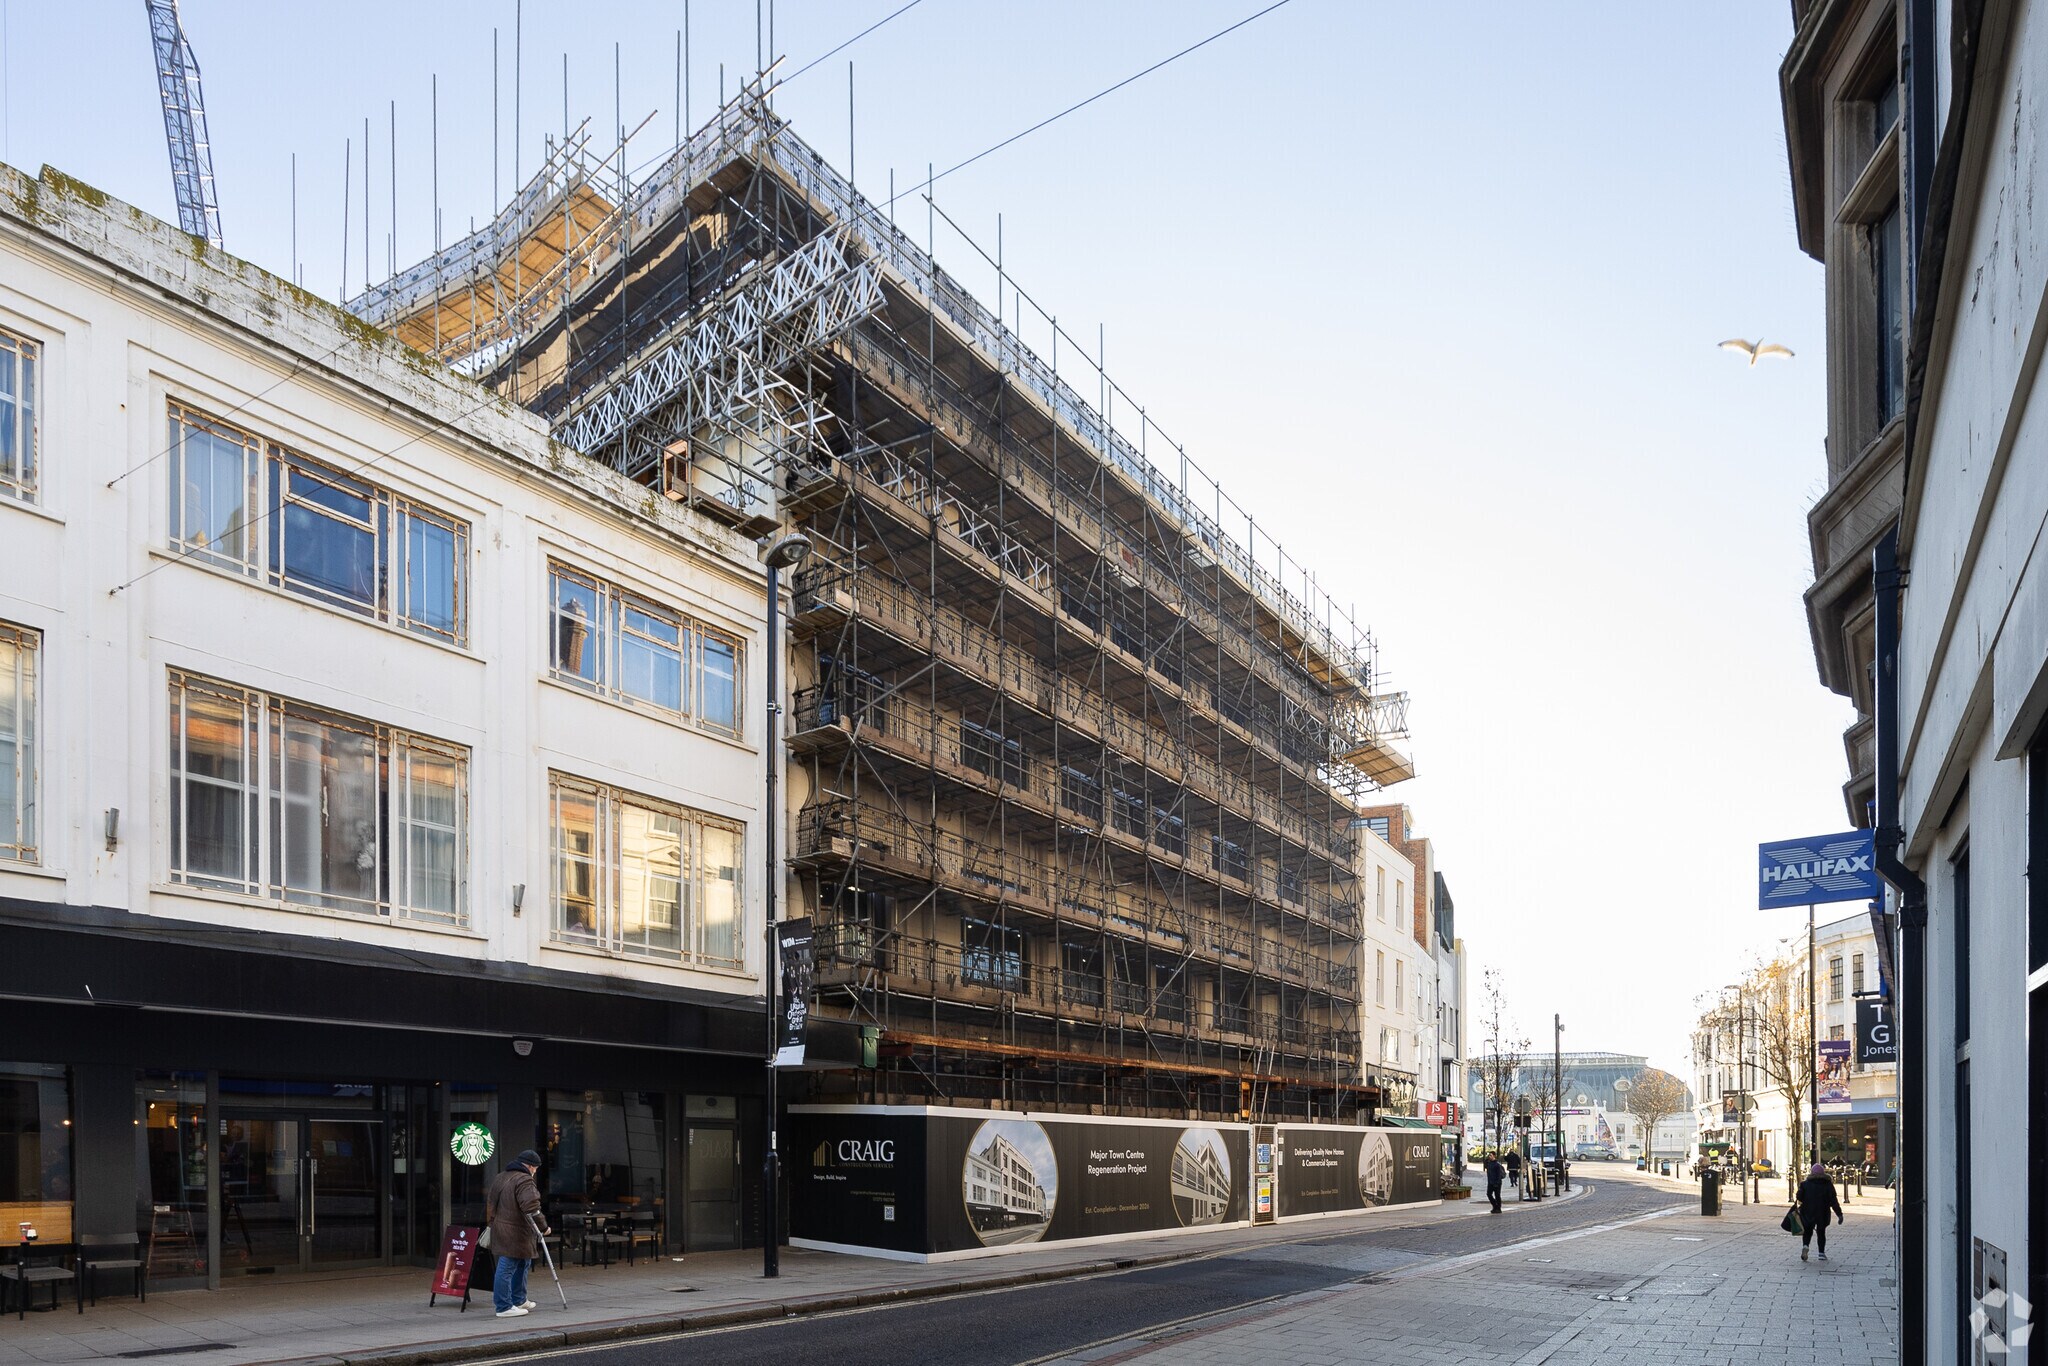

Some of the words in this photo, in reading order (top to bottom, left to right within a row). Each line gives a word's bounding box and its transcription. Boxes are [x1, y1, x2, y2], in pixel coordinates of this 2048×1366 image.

[1762, 855, 1871, 882] HALIFAX
[1870, 1004, 1883, 1022] T
[1870, 1025, 1889, 1044] G
[1863, 1046, 1897, 1057] Jones
[1448, 1115, 1453, 1124] TO
[838, 1140, 895, 1162] CRAIG
[1090, 1150, 1108, 1161] Major
[1109, 1150, 1124, 1159] Town
[1126, 1150, 1144, 1159] Centre
[1294, 1148, 1312, 1157] Delivering
[1313, 1148, 1324, 1157] Quality
[1413, 1146, 1430, 1157] CRAIG
[1326, 1159, 1338, 1167] Spaces
[1088, 1165, 1126, 1176] Regeneration
[1128, 1164, 1147, 1175] Project
[1093, 1205, 1116, 1214] Completion
